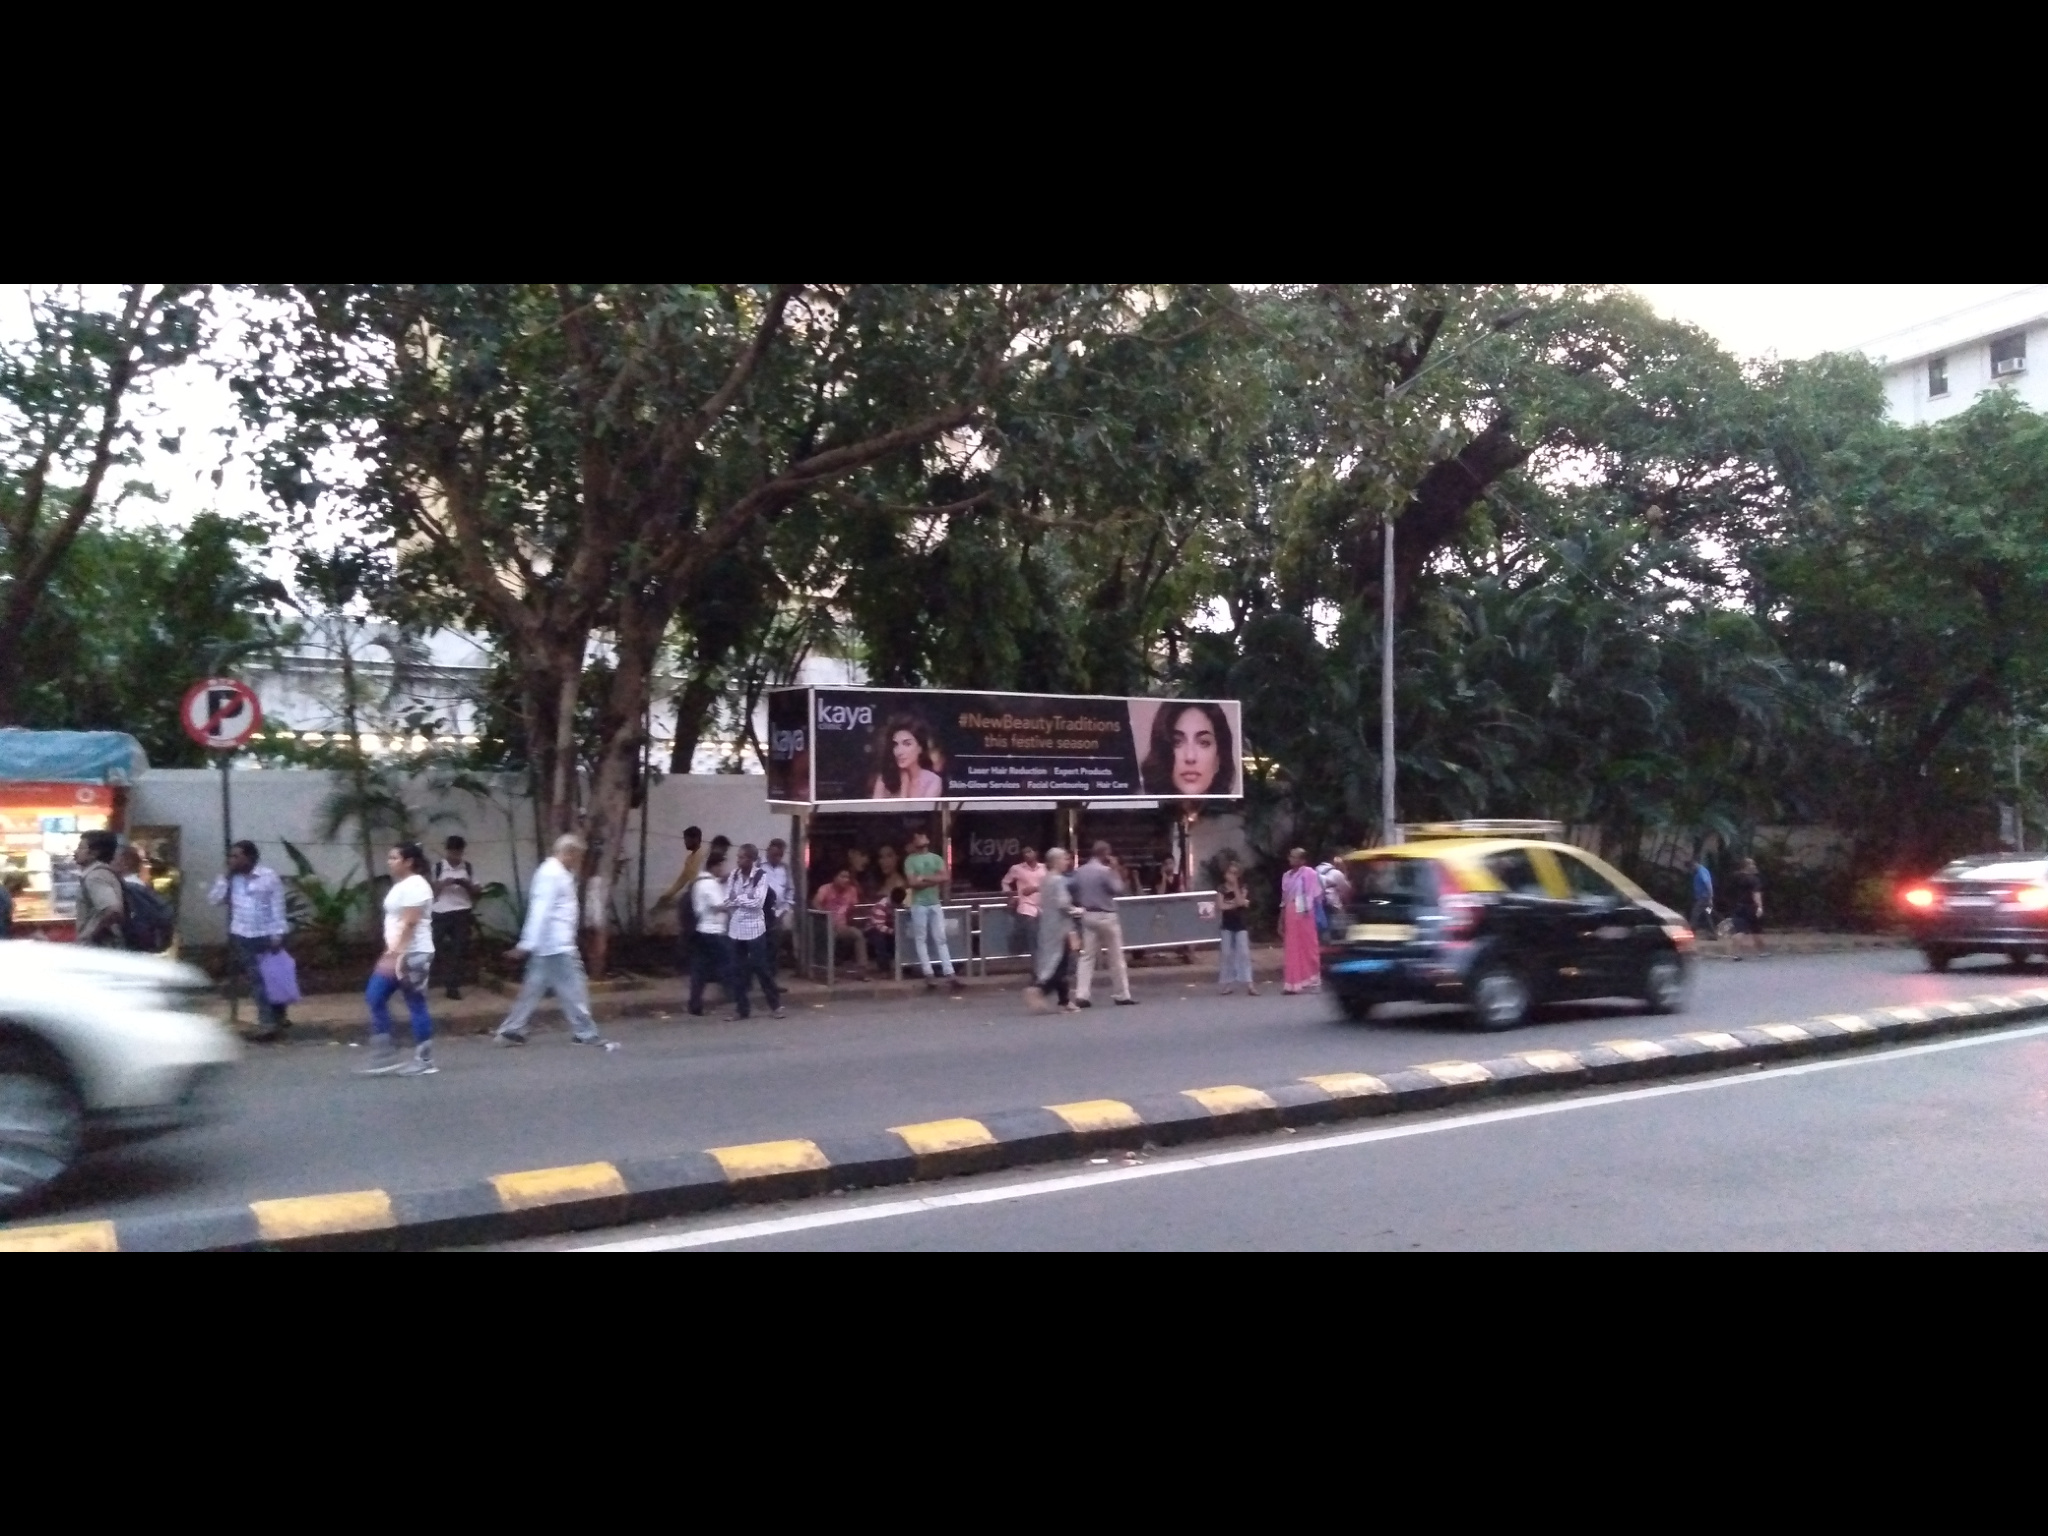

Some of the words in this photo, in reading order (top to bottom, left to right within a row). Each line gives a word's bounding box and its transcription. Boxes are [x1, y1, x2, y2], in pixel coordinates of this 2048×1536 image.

[817, 698, 873, 730] kaya
[958, 713, 1121, 734] #NewBeautyTraditions
[984, 735, 1008, 748] this
[1011, 734, 1053, 749] festive
[1056, 739, 1099, 749] season
[968, 766, 989, 775] Laser
[991, 766, 1008, 775] Hair
[1009, 766, 1047, 775] Reduction
[1054, 767, 1079, 777] Expert
[1080, 767, 1113, 776] Products
[949, 780, 988, 790] Skin-Glow
[989, 780, 1020, 789] Services
[1027, 780, 1048, 789] Facial
[1049, 781, 1090, 791] Contouring
[1096, 781, 1111, 789] Hair
[1112, 781, 1129, 789] Care
[969, 832, 1020, 863] kaya
